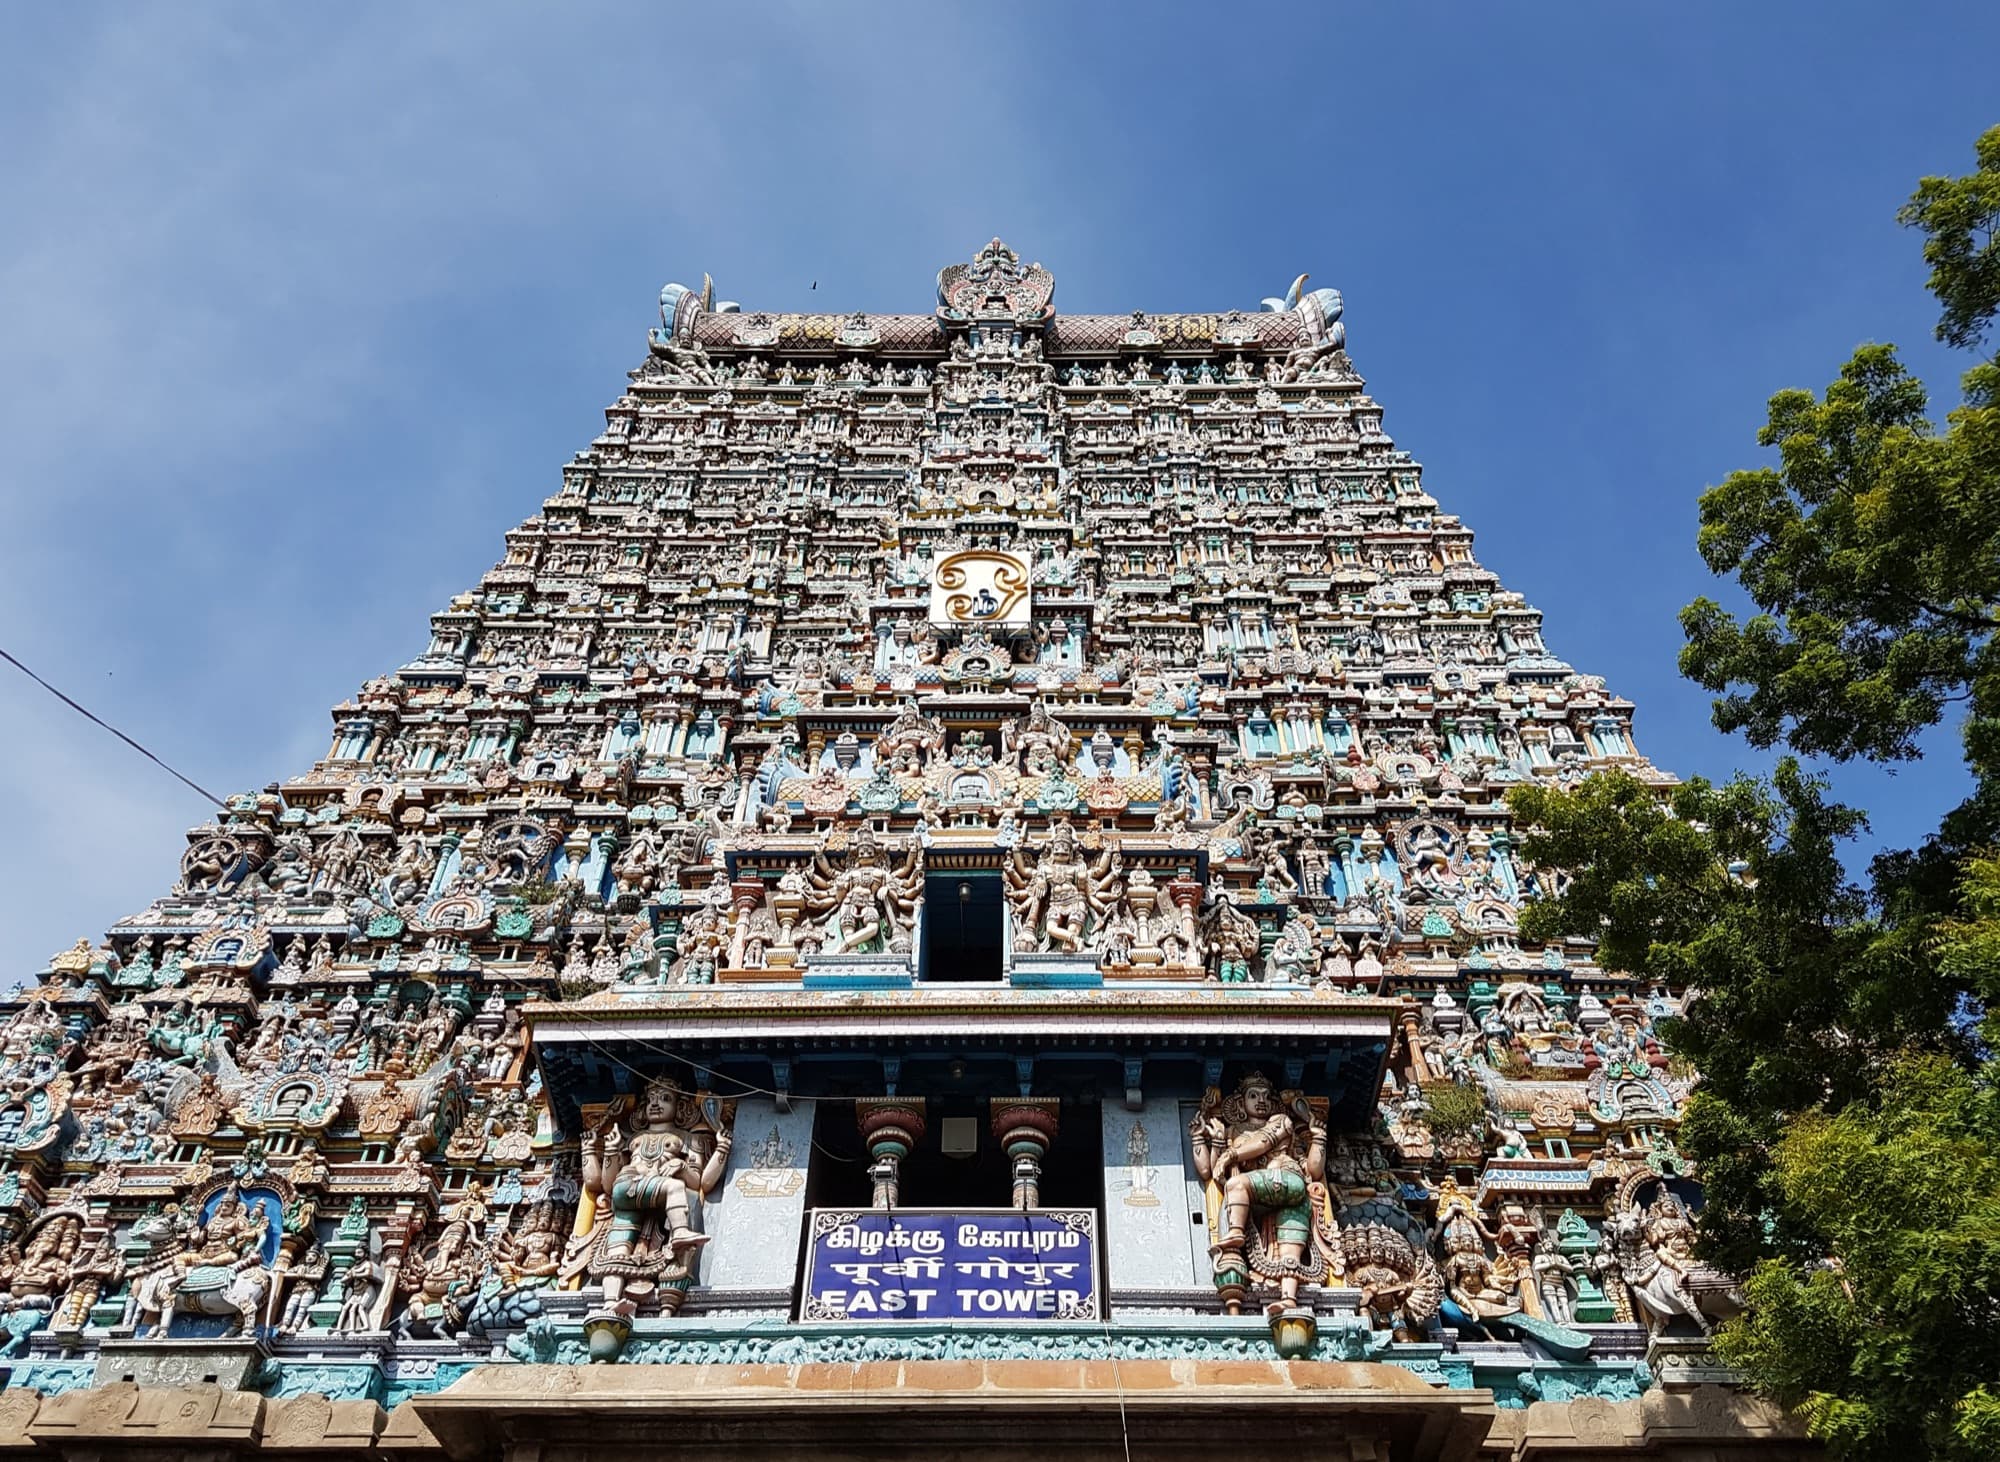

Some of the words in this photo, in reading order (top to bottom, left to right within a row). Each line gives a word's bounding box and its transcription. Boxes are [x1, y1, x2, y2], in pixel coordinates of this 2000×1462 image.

[826, 1224, 945, 1256] கிழக்கு
[958, 1224, 1080, 1254] கோபுரம்
[830, 1257, 945, 1286] पूर्वी
[955, 1256, 1079, 1286] गोपुर
[821, 1289, 937, 1312] EAST
[956, 1289, 1080, 1312] TOWER
